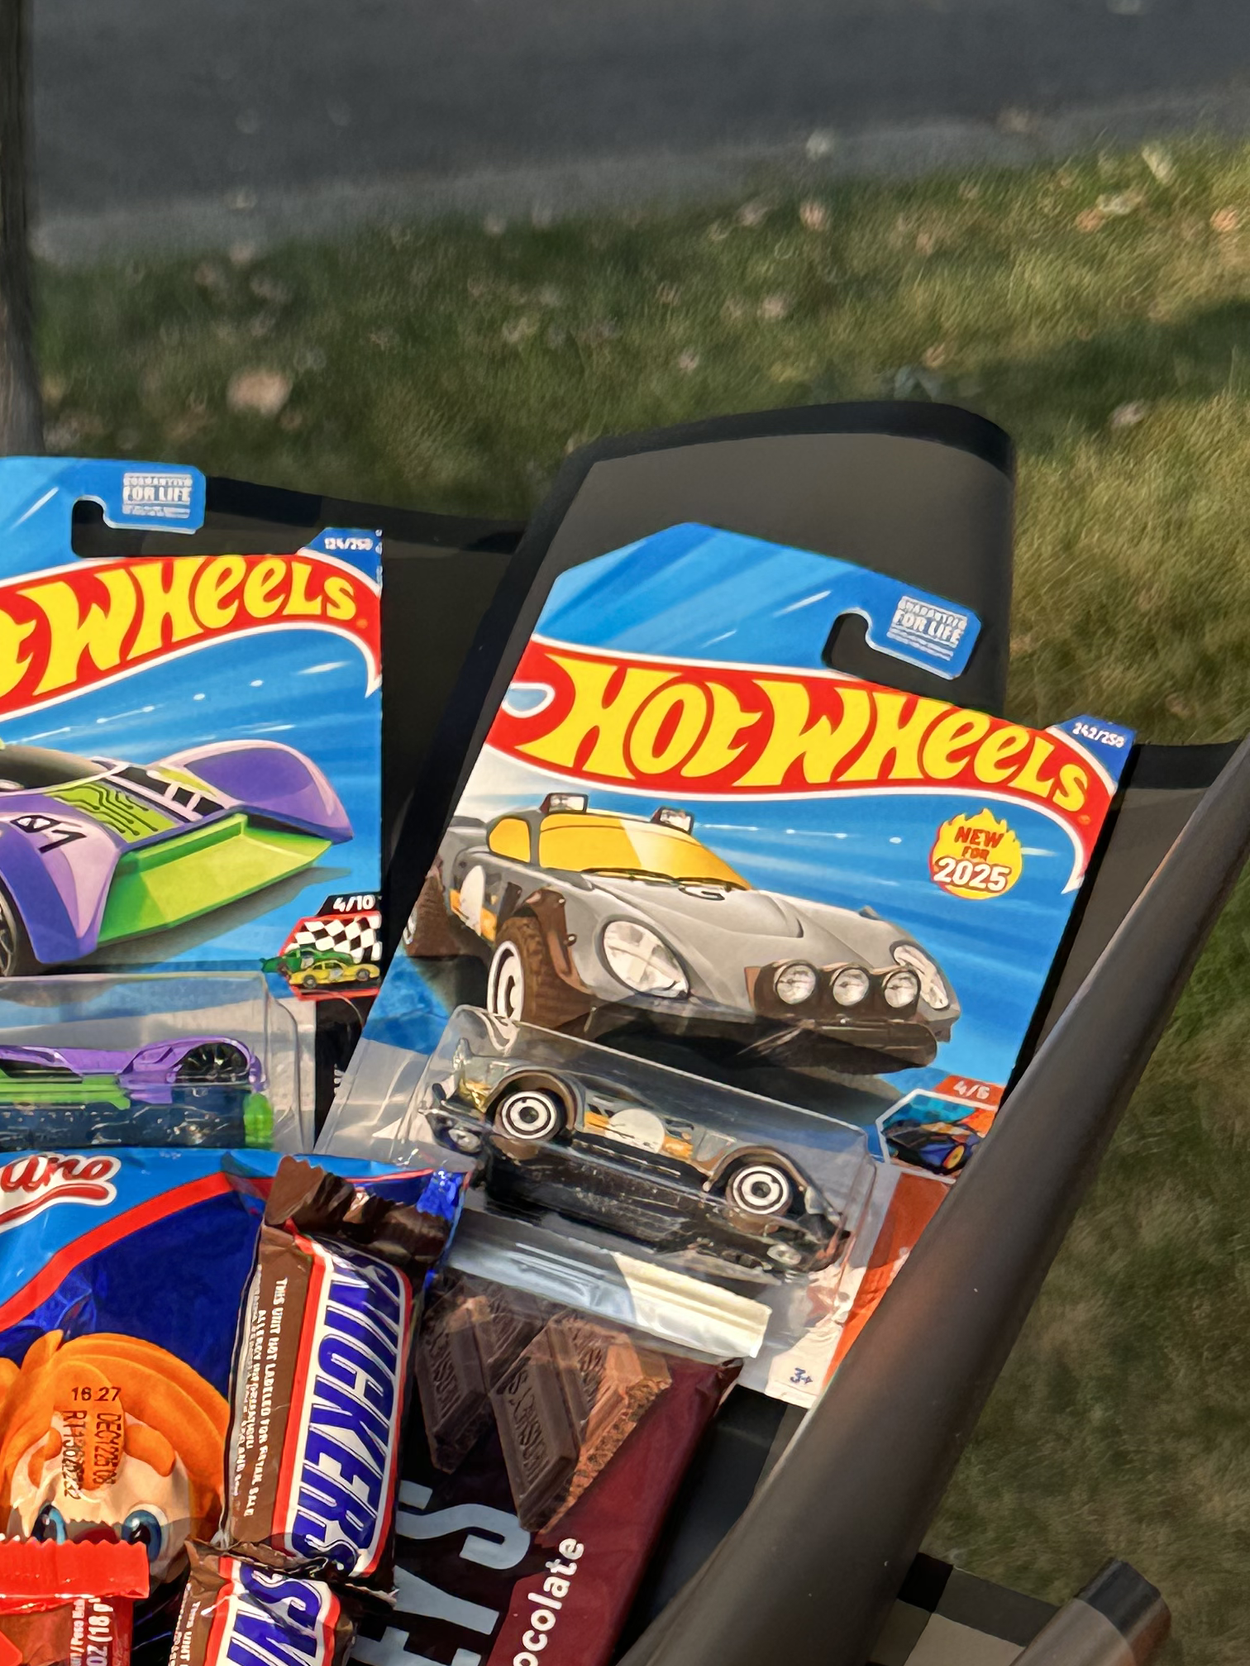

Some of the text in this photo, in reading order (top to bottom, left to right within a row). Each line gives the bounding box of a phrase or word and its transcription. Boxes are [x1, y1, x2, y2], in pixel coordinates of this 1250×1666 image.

[123, 486, 191, 501] FOR LIFE
[892, 609, 965, 644] FOR LIFE
[515, 654, 763, 780] HOT
[954, 826, 1004, 848] NEW
[933, 857, 1011, 891] 2025
[333, 895, 375, 912] 4/10
[94, 1386, 121, 1401] 27
[87, 1615, 113, 1643] (18
